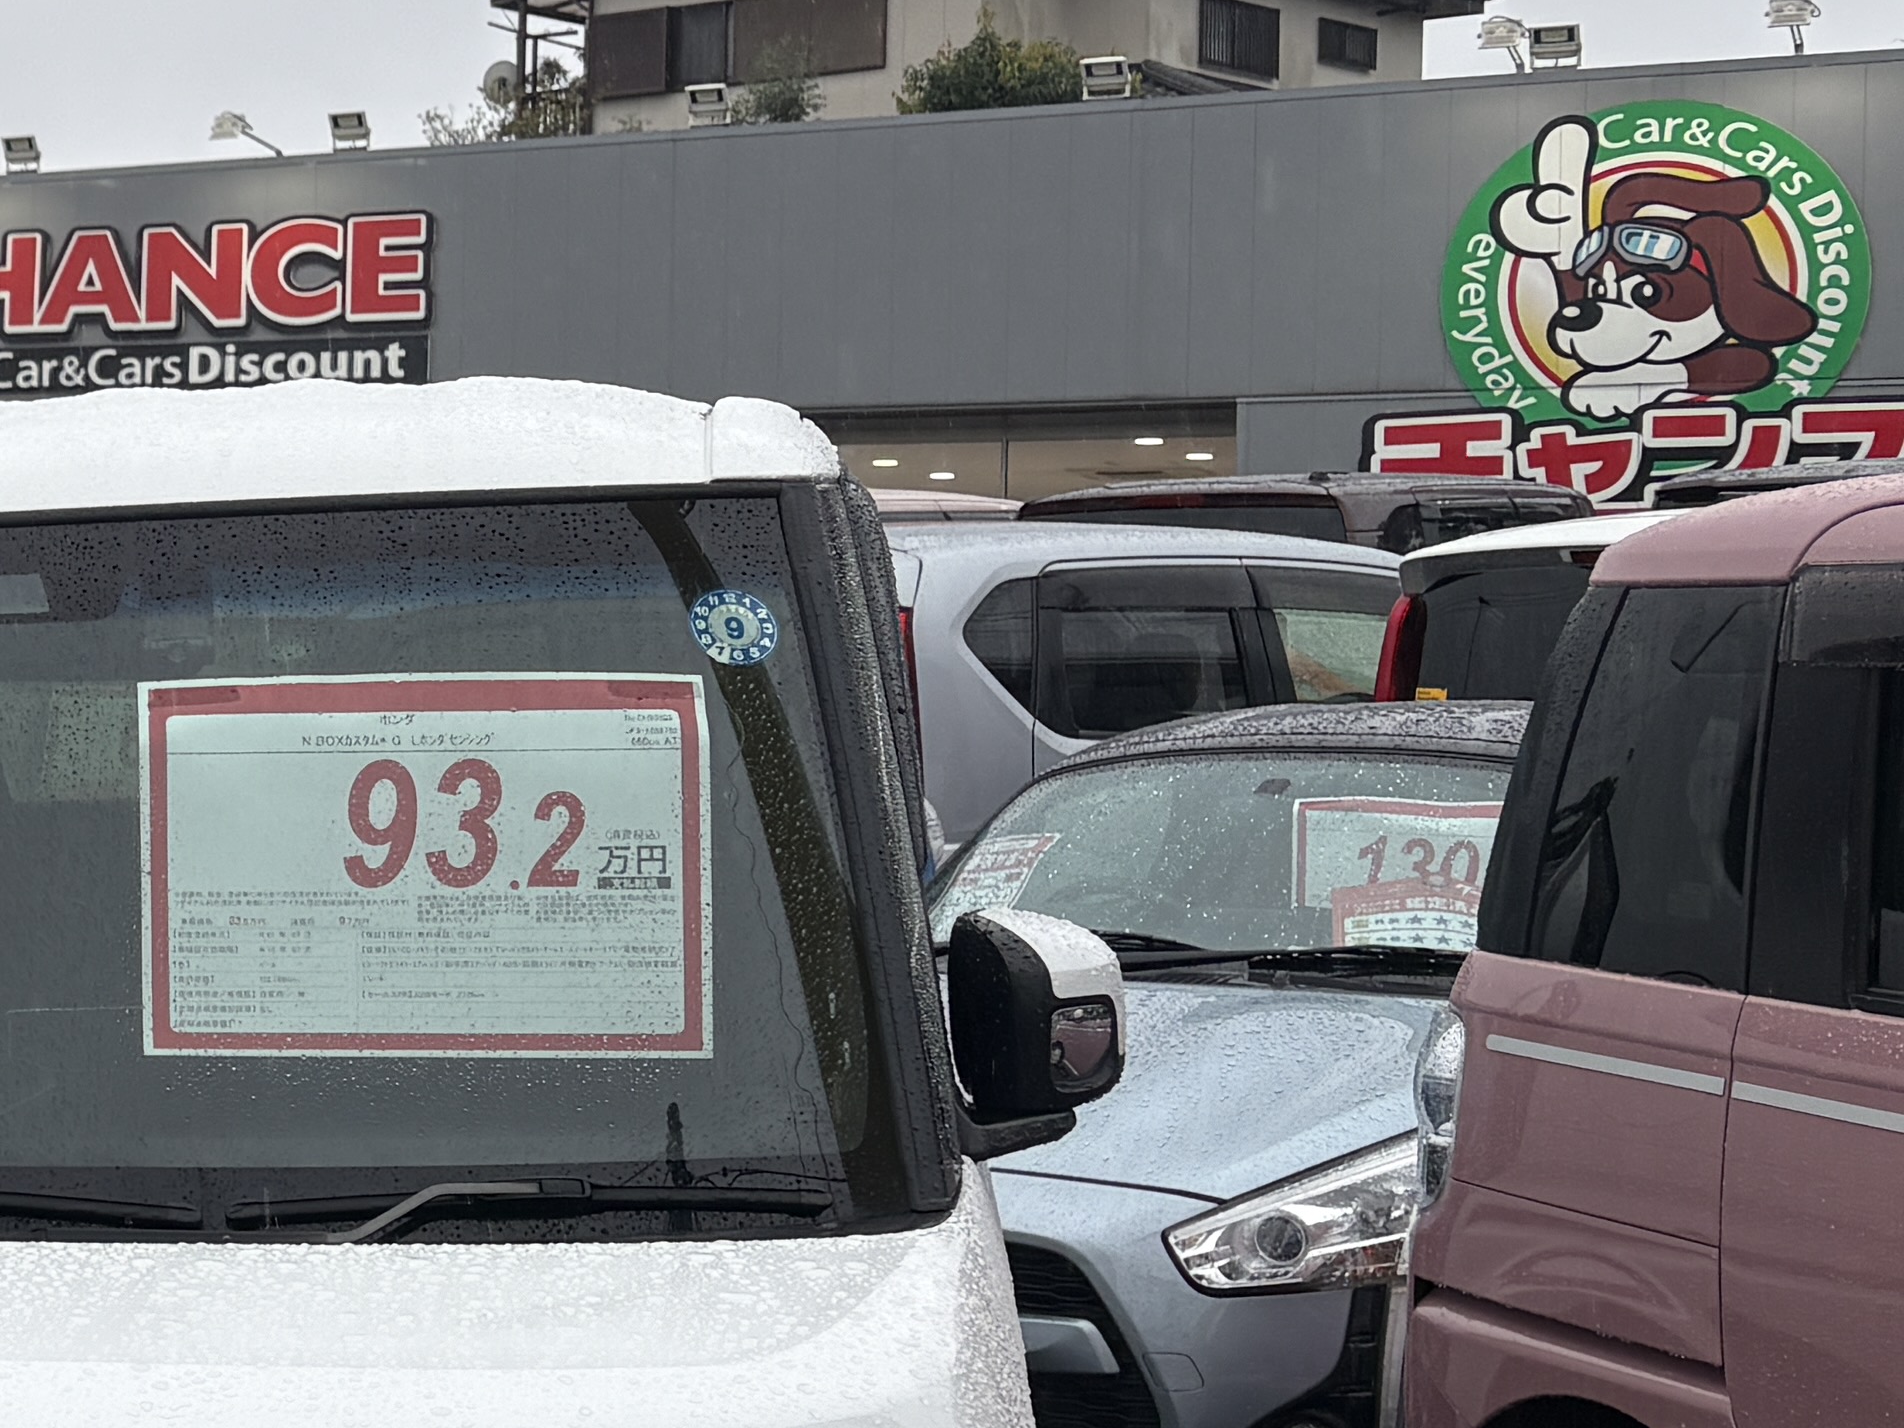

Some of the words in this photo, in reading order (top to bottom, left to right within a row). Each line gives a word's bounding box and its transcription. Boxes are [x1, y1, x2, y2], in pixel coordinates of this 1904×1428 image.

[1597, 110, 1813, 197] Car&Cars
[1774, 188, 1852, 398] Discount
[187, 341, 406, 387] Discount
[1450, 230, 1537, 412] everyday
[723, 616, 745, 640] 9
[342, 758, 587, 891] 93.2
[597, 845, 668, 875] 万円
